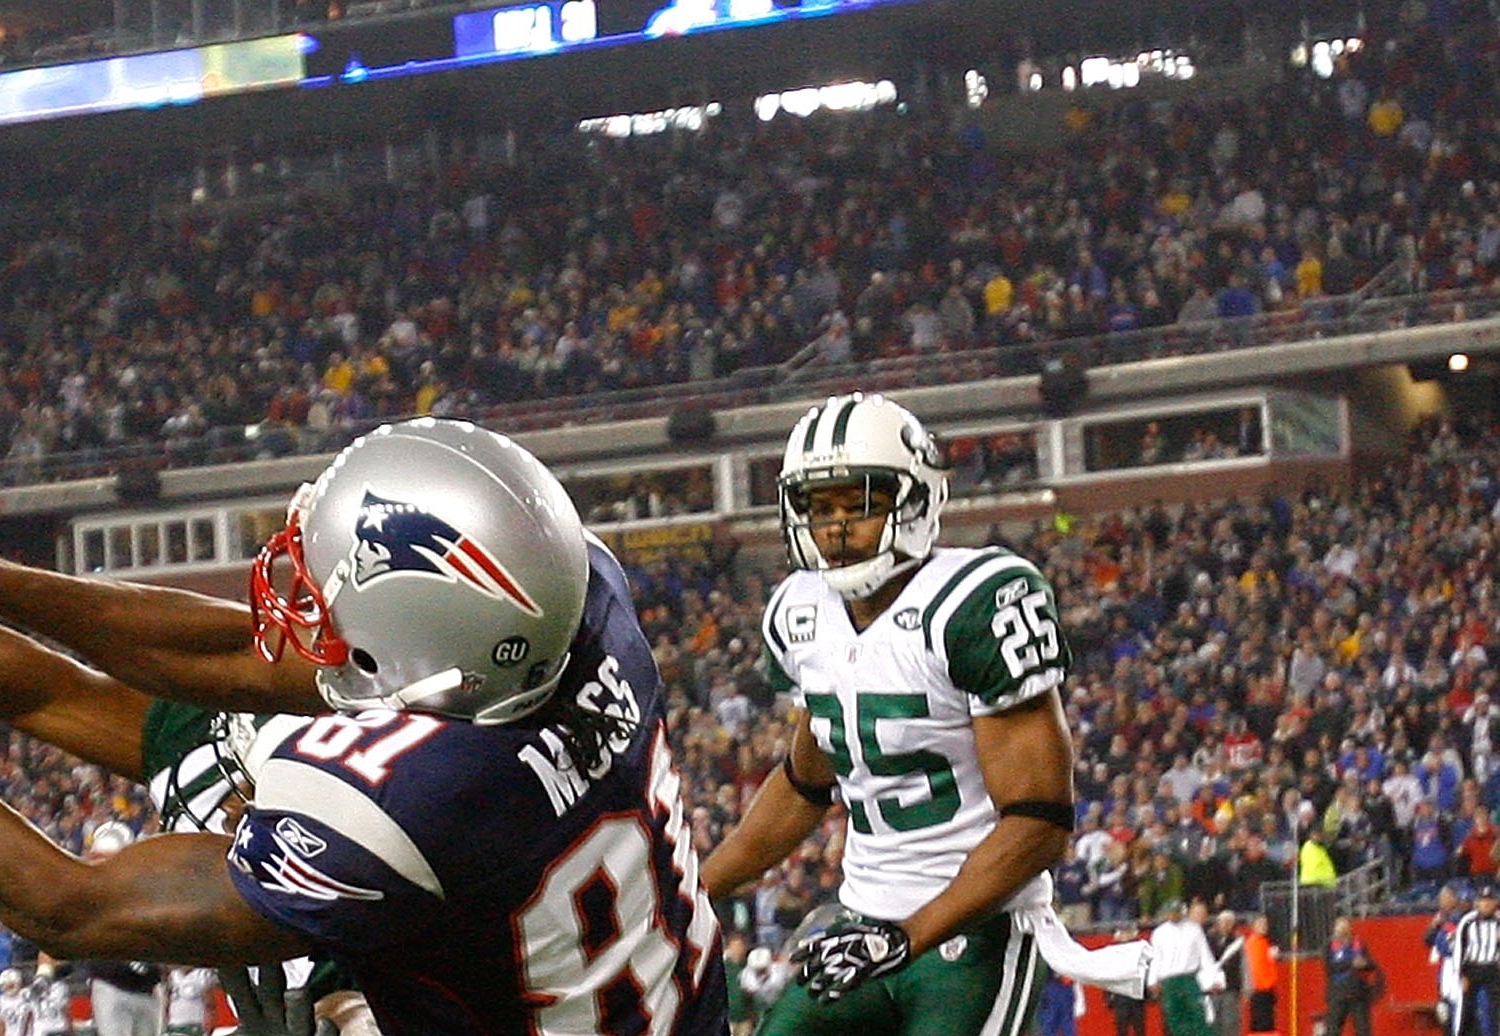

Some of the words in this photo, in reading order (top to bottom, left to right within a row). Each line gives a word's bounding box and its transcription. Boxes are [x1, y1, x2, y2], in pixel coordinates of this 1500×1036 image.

[496, 641, 527, 661] GU
[991, 590, 1059, 679] 25
[296, 711, 446, 787] 81
[804, 691, 962, 836] 25
